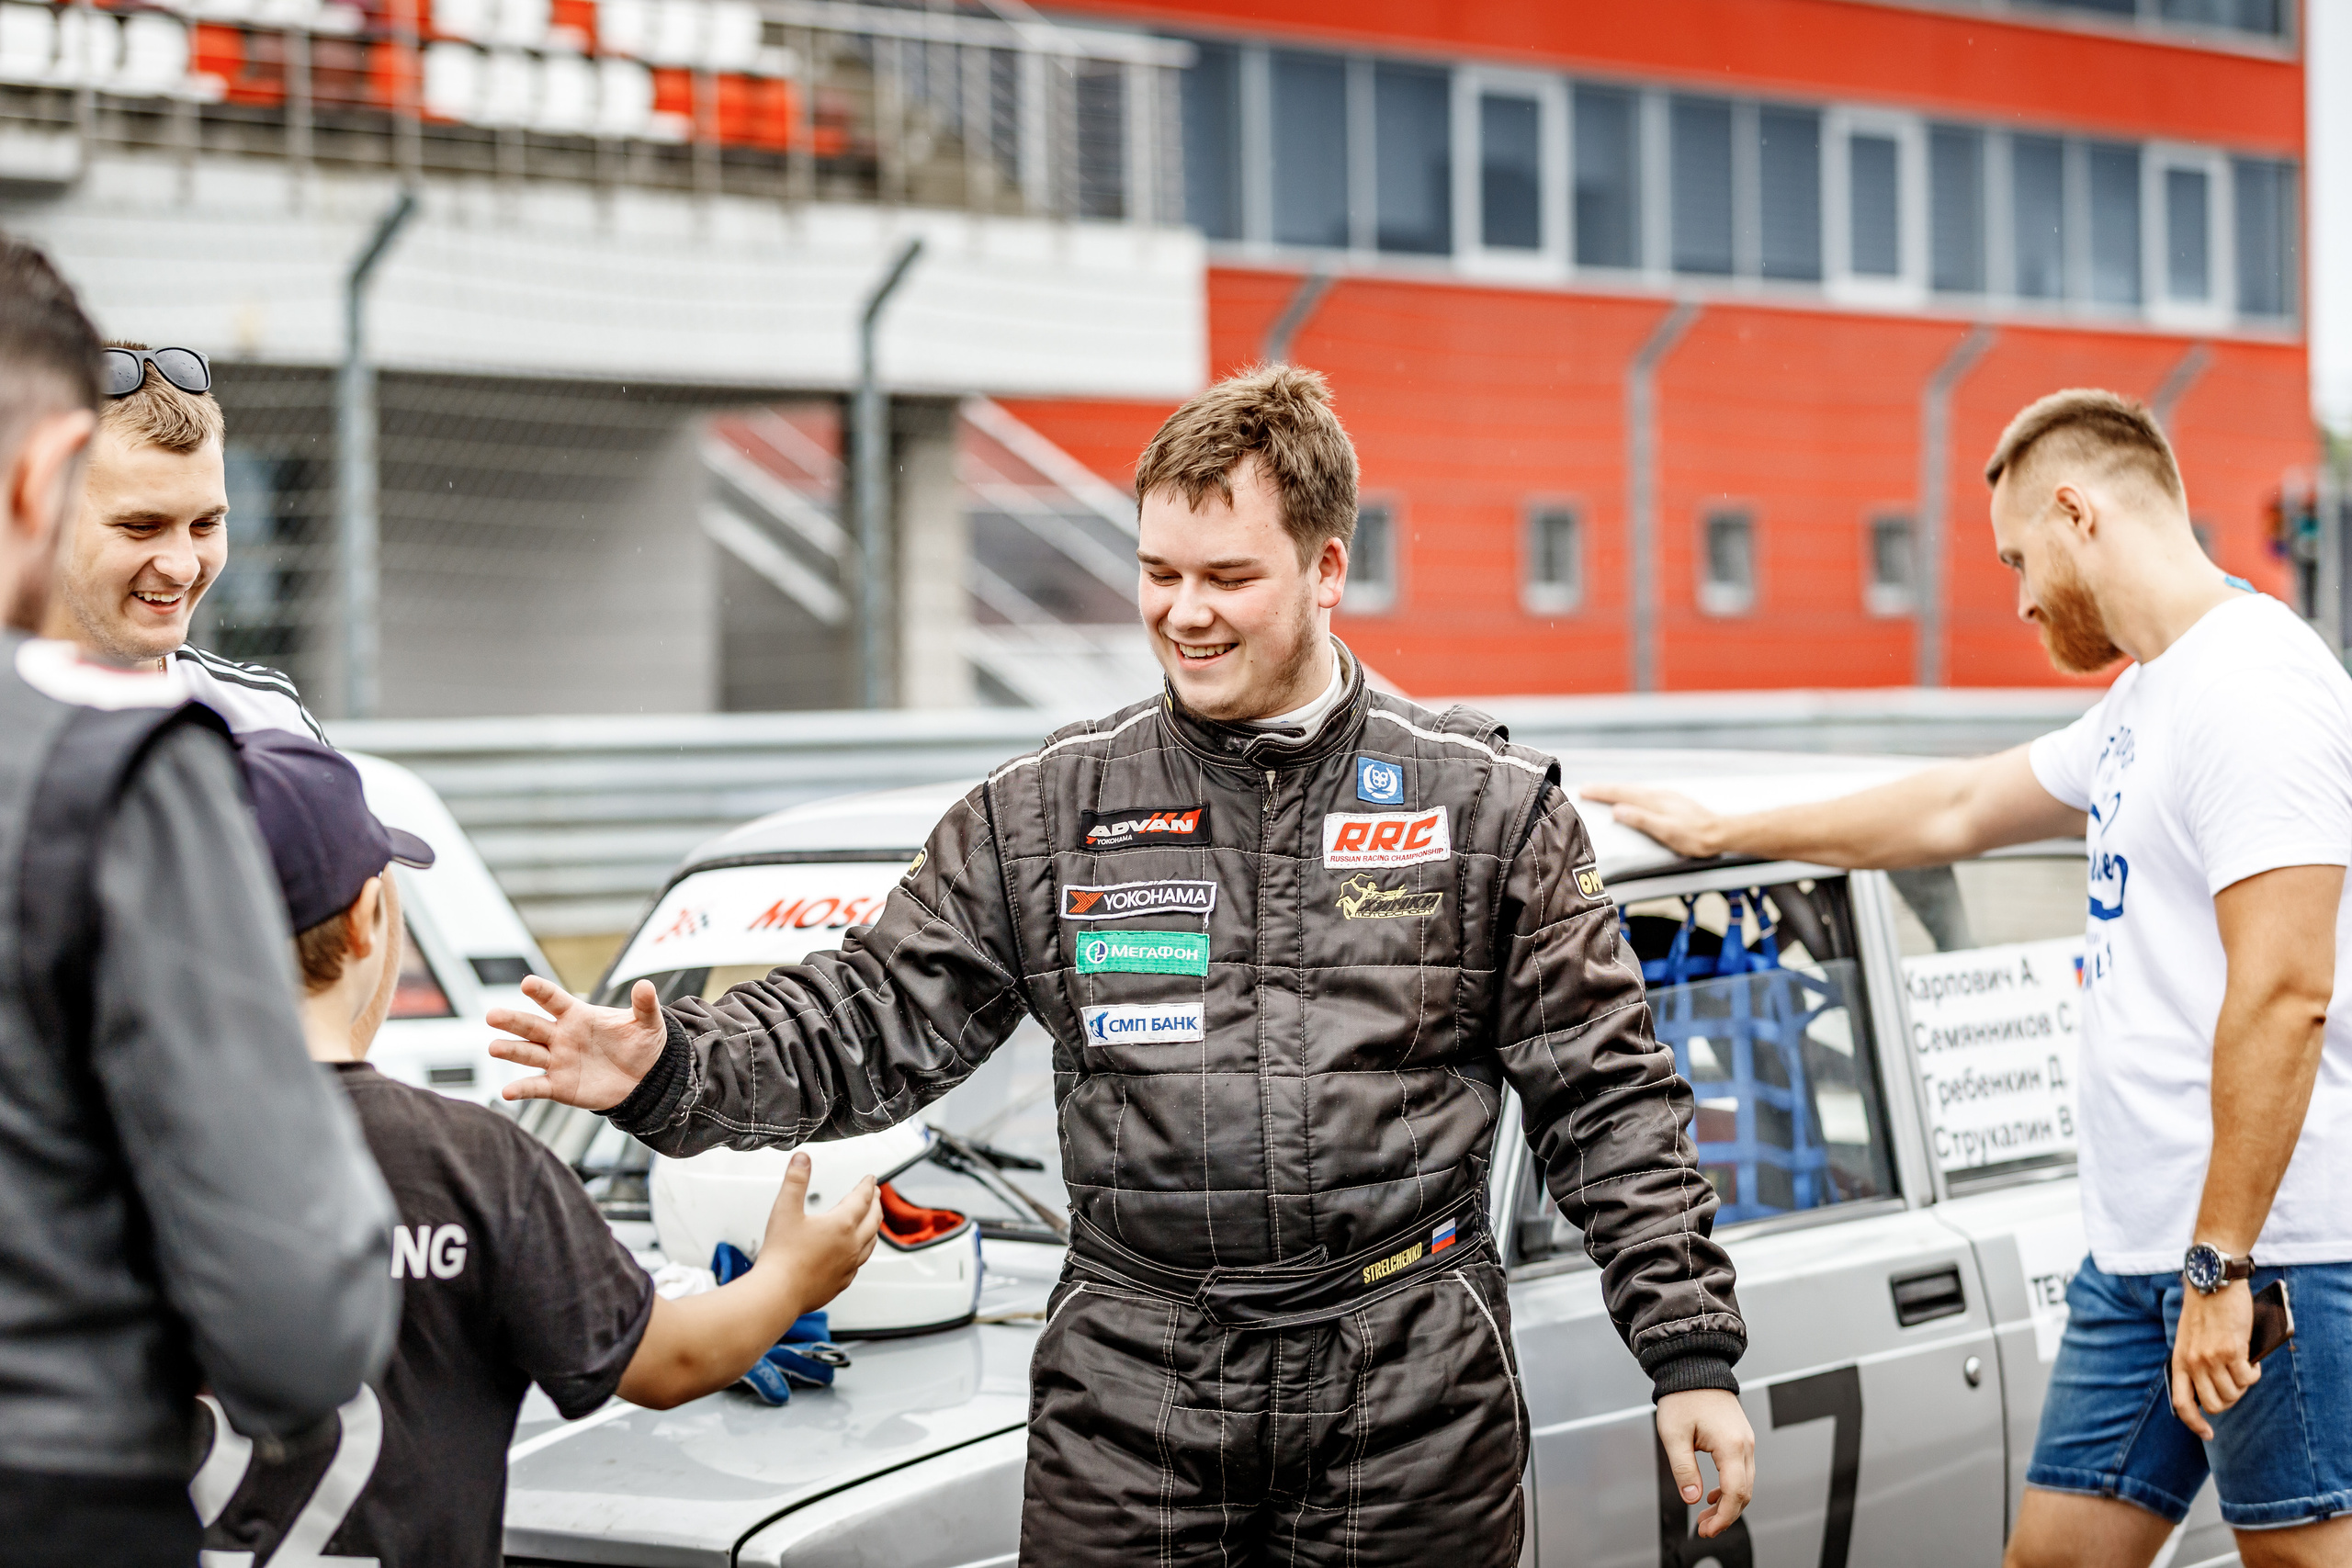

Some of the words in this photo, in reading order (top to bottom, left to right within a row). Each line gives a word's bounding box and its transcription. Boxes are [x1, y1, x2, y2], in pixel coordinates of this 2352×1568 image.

[1087, 818, 1193, 837] ADVAN
[1096, 834, 1133, 845] YOKOHAMA
[1332, 815, 1439, 852] RRC
[1363, 854, 1390, 863] RACING
[1391, 847, 1444, 862] CHAMPIONSHIP
[1578, 870, 1604, 895] OM
[1102, 887, 1207, 911] YOKOHAMA
[1108, 1018, 1147, 1032] СМП
[1151, 1016, 1198, 1032] БАНК
[1913, 1013, 2052, 1054] Семянников
[1923, 1066, 2041, 1113] Гребенкин
[390, 1223, 468, 1280] NG
[1363, 1242, 1423, 1284] STRELCHENKO
